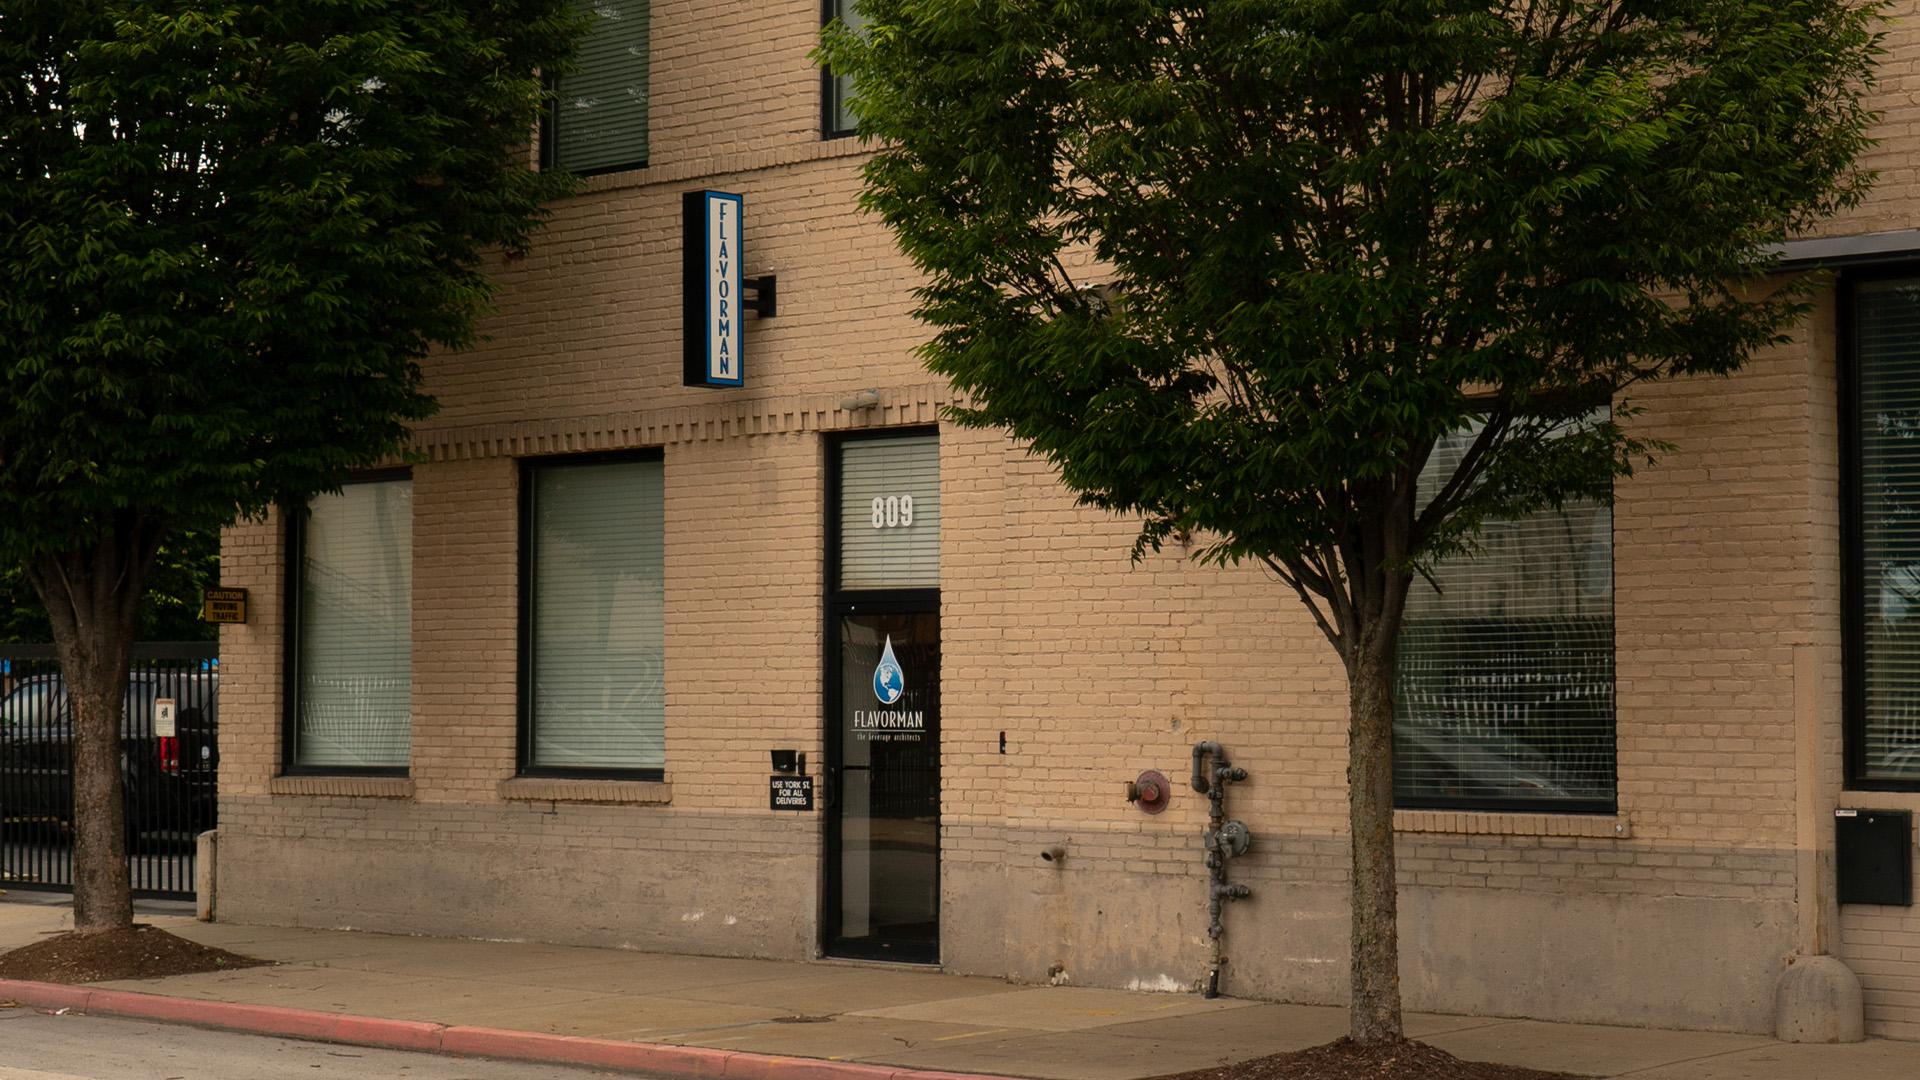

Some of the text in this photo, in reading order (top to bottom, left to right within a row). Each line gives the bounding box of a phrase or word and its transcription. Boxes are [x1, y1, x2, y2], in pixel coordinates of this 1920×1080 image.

[718, 202, 730, 375] FLAVORMAN
[871, 494, 913, 529] 809
[207, 591, 244, 600] CAUTION
[211, 611, 240, 621] TRAFFIC
[854, 710, 923, 728] FLAVORMAN
[857, 733, 866, 741] the
[772, 781, 783, 789] USE
[785, 781, 801, 789] YORK
[779, 789, 804, 797] FOR ALL
[775, 797, 807, 805] DELIVERIES
